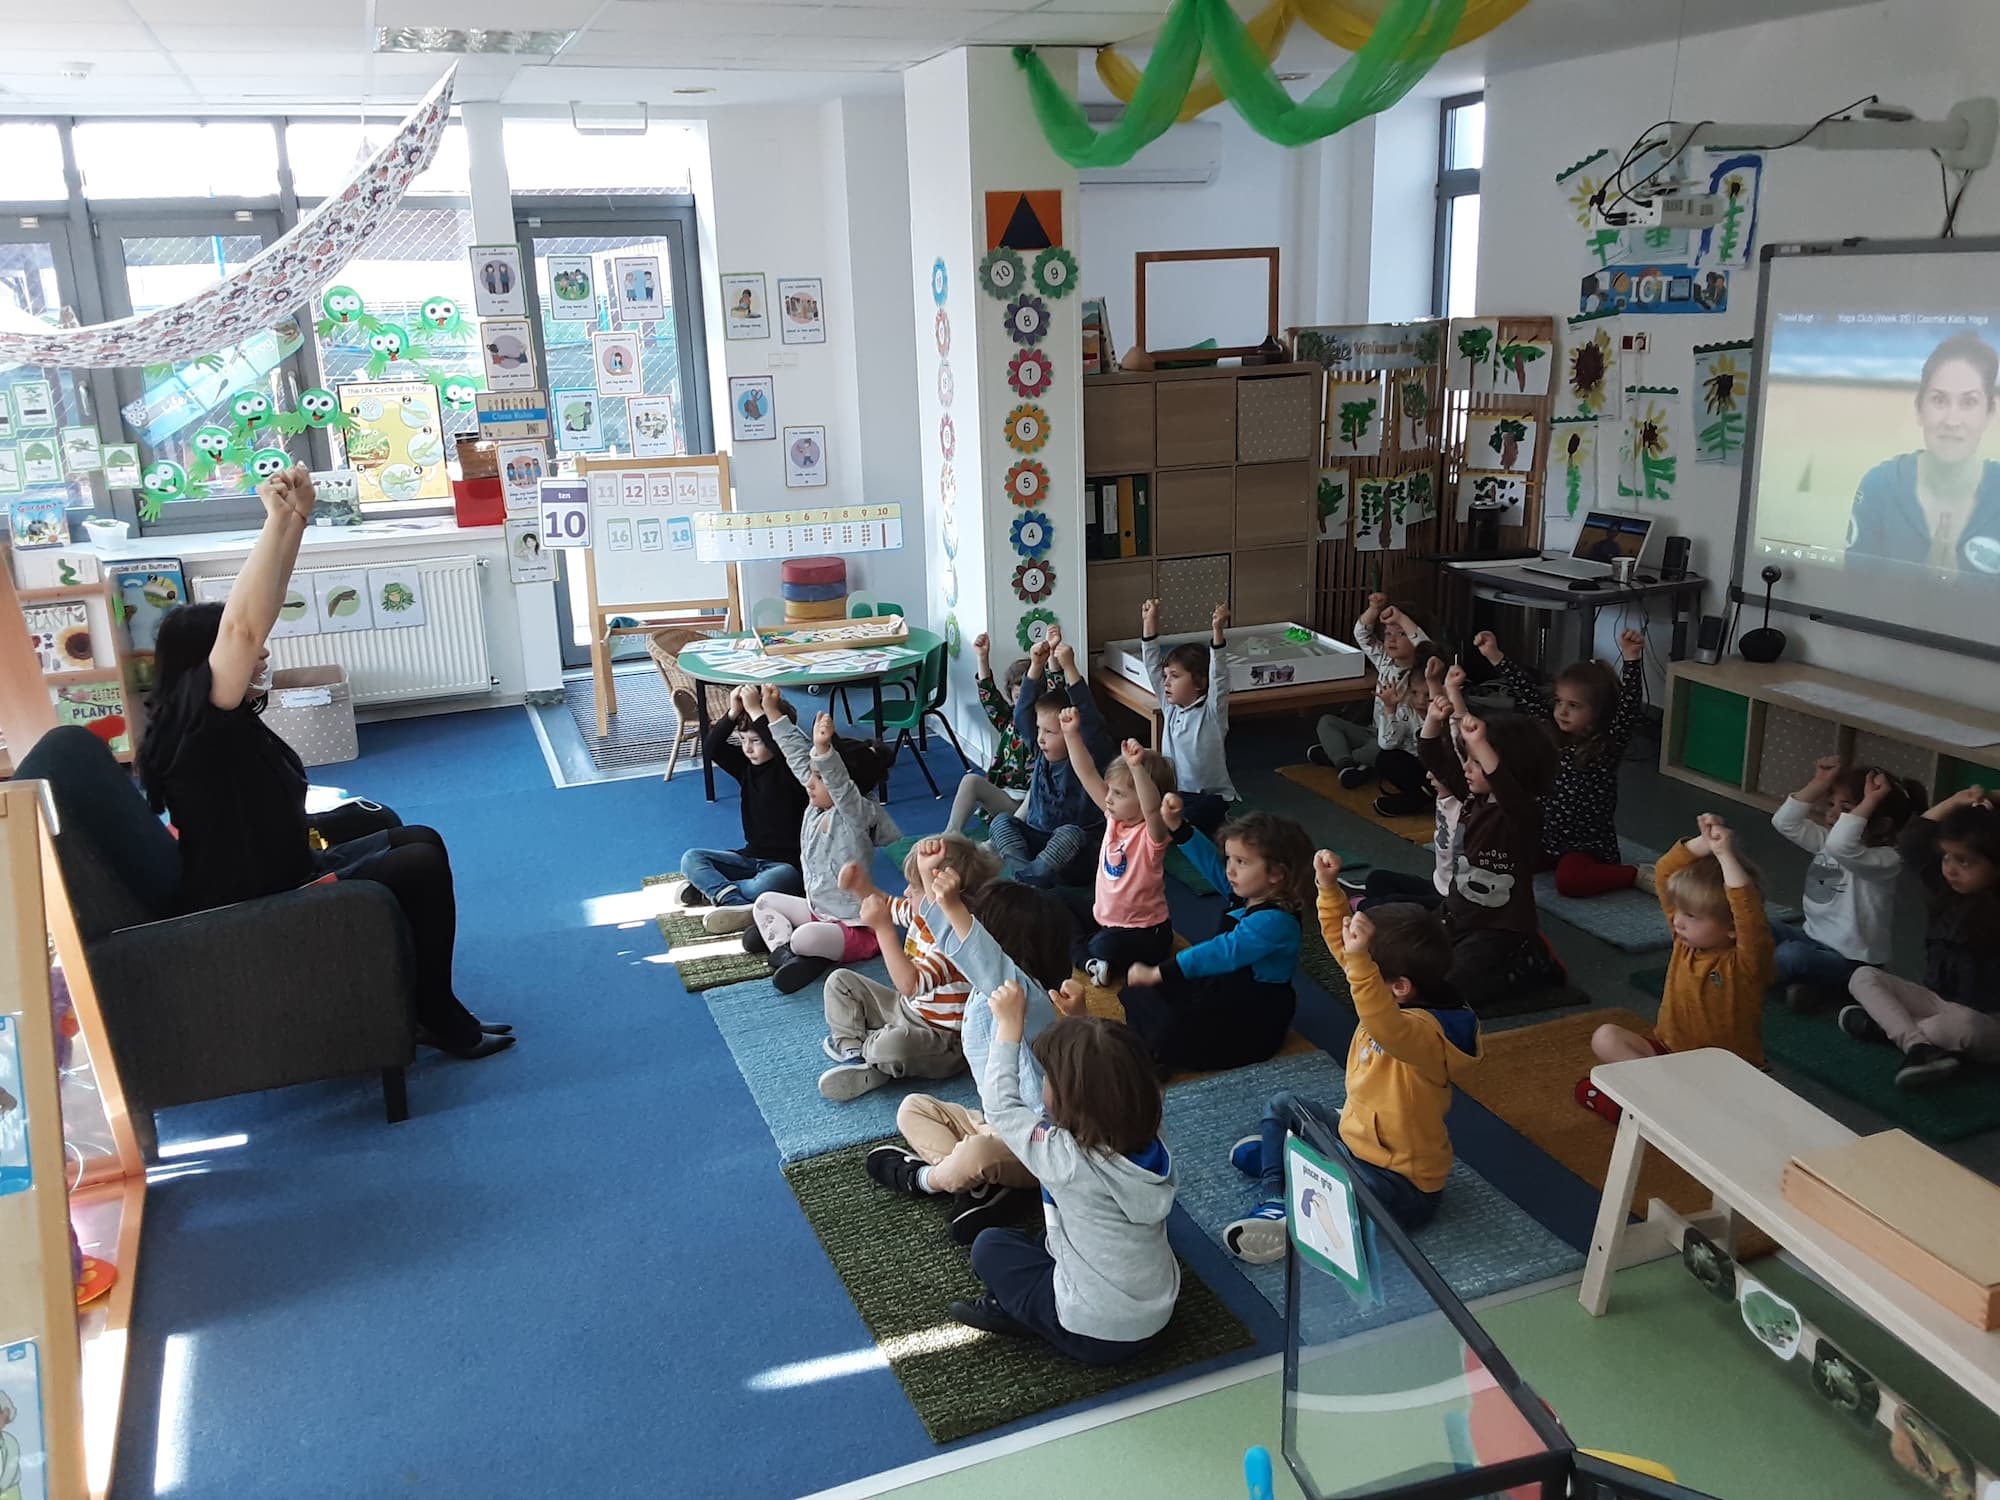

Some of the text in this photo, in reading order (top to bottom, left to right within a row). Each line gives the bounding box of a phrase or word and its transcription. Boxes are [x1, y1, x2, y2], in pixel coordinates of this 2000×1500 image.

[995, 264, 1011, 281] 10
[1050, 266, 1059, 280] 9
[1630, 275, 1674, 304] ICT
[1023, 314, 1032, 328] 8
[1025, 367, 1033, 380] 7
[1023, 422, 1031, 434] 6
[1023, 477, 1031, 489] 5
[597, 486, 616, 498] 11
[625, 485, 643, 498] 12
[652, 485, 671, 498] 13
[679, 484, 696, 498] 14
[726, 518, 732, 526] 2
[745, 517, 751, 525] 3
[766, 515, 772, 524] 4
[785, 514, 791, 523] 5
[804, 512, 810, 521] 6
[822, 511, 828, 520] 7
[843, 510, 849, 519] 8
[862, 509, 868, 518] 9
[878, 507, 888, 516] 10
[545, 510, 587, 538] 10
[611, 530, 629, 543] 16
[643, 530, 659, 543] 17
[672, 529, 690, 542] 18
[1028, 528, 1036, 540] 4
[1030, 574, 1039, 586] 3
[1034, 626, 1042, 639] 2
[72, 704, 123, 719] PLANTS
[1303, 1163, 1333, 1193] pincer grip
